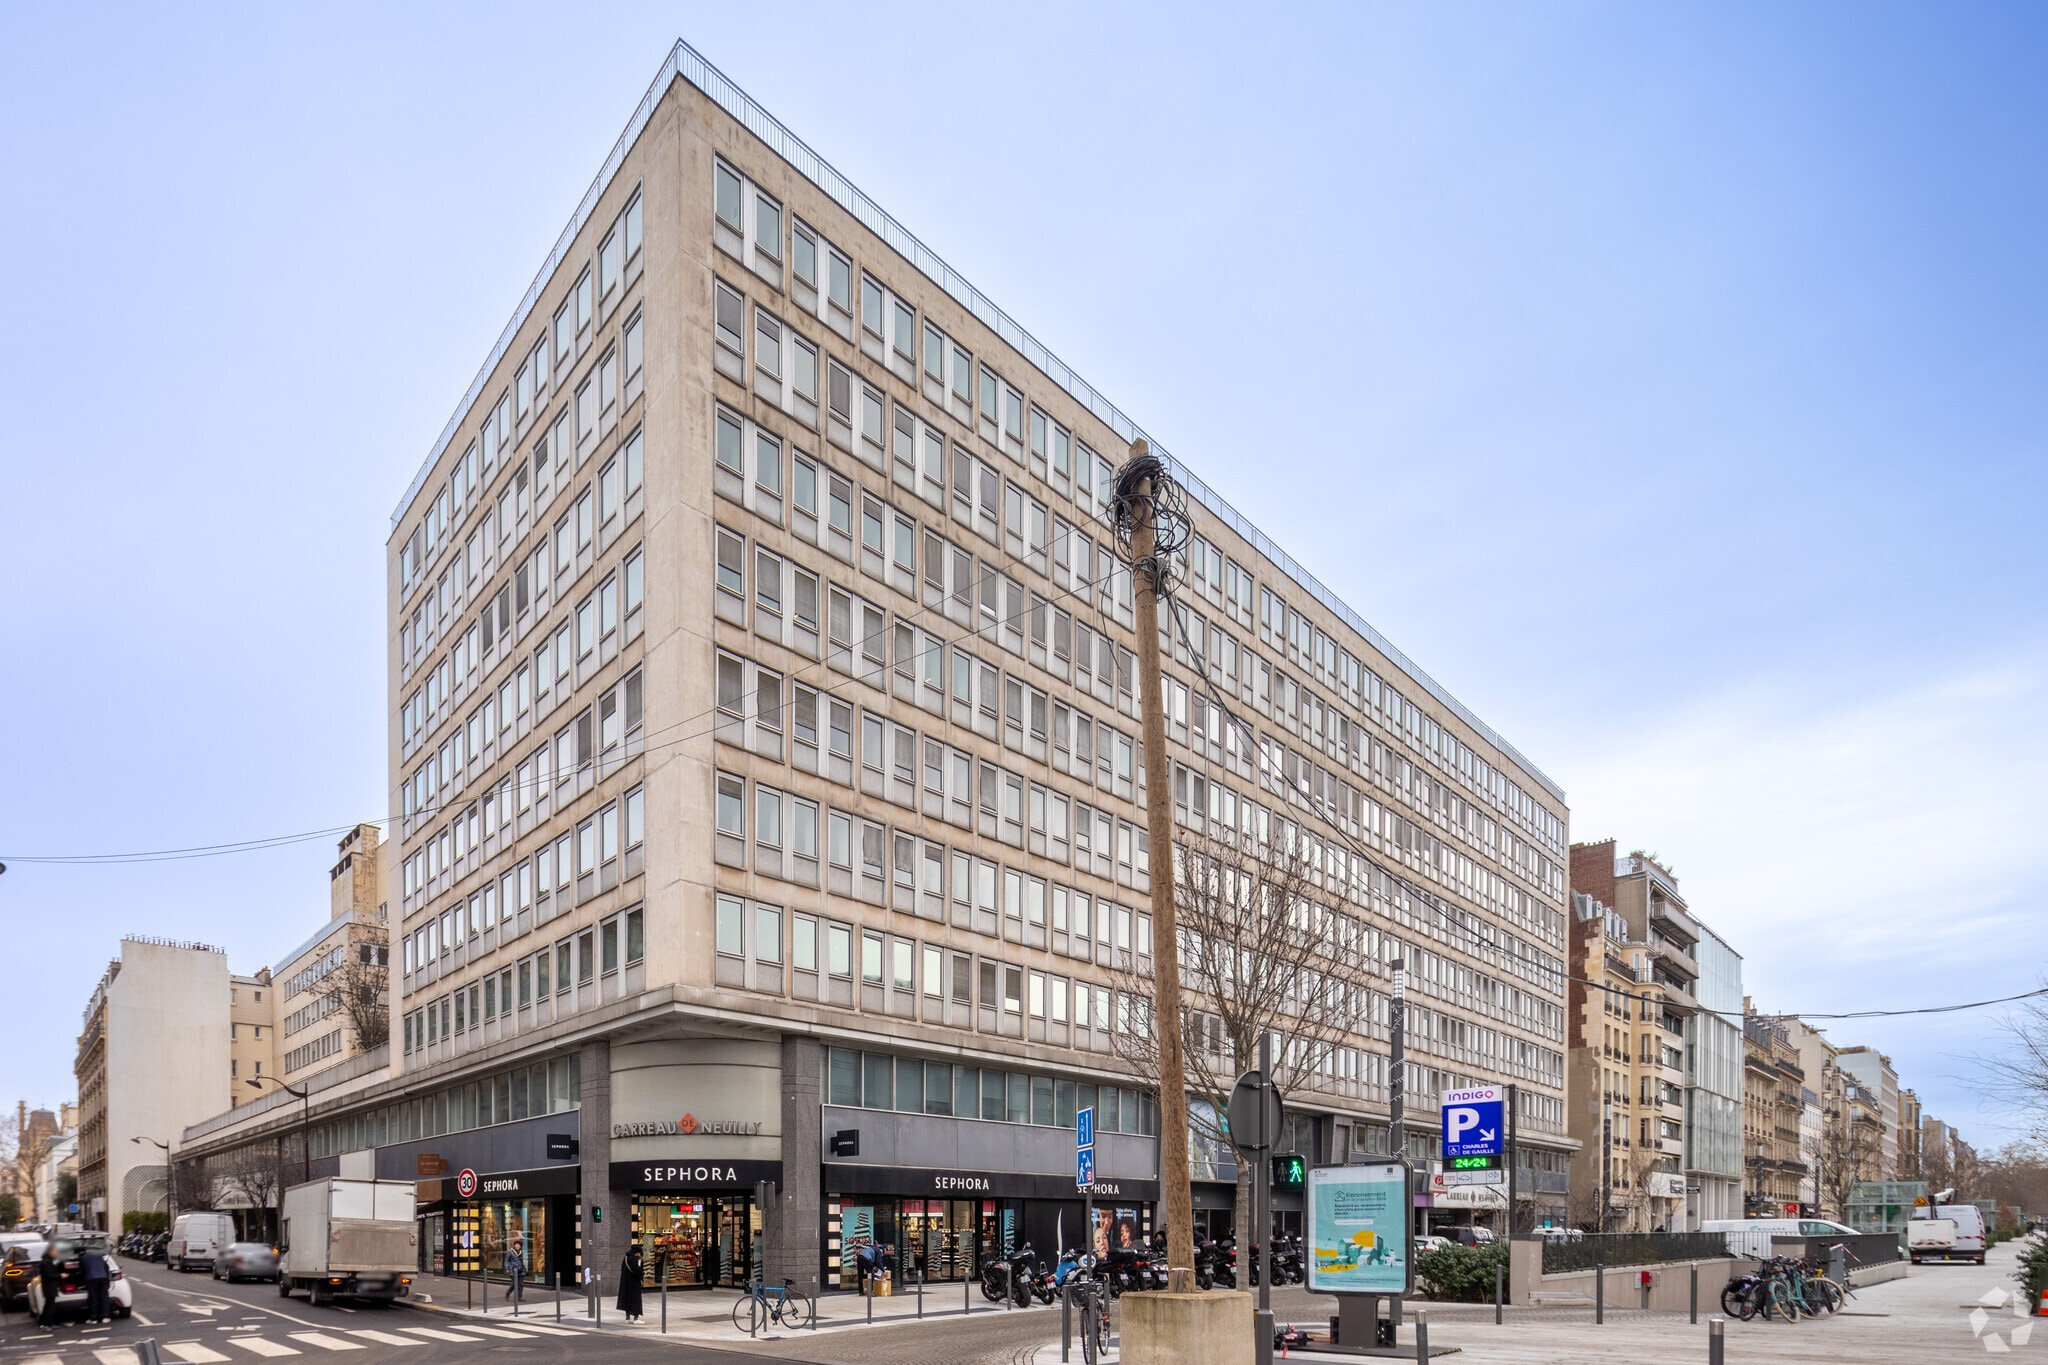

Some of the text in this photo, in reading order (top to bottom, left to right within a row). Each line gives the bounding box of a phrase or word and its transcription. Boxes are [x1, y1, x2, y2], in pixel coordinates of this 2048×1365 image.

[1448, 1090, 1494, 1102] INDIGO
[613, 1119, 762, 1137] CARREAU DE NEUILLY
[1447, 1107, 1480, 1143] P
[1455, 1157, 1487, 1168] 24/24
[644, 1167, 737, 1182] SEPHORA
[462, 1177, 472, 1188] 30
[484, 1179, 518, 1193] SEPHORA
[935, 1176, 990, 1190] SEPHORA
